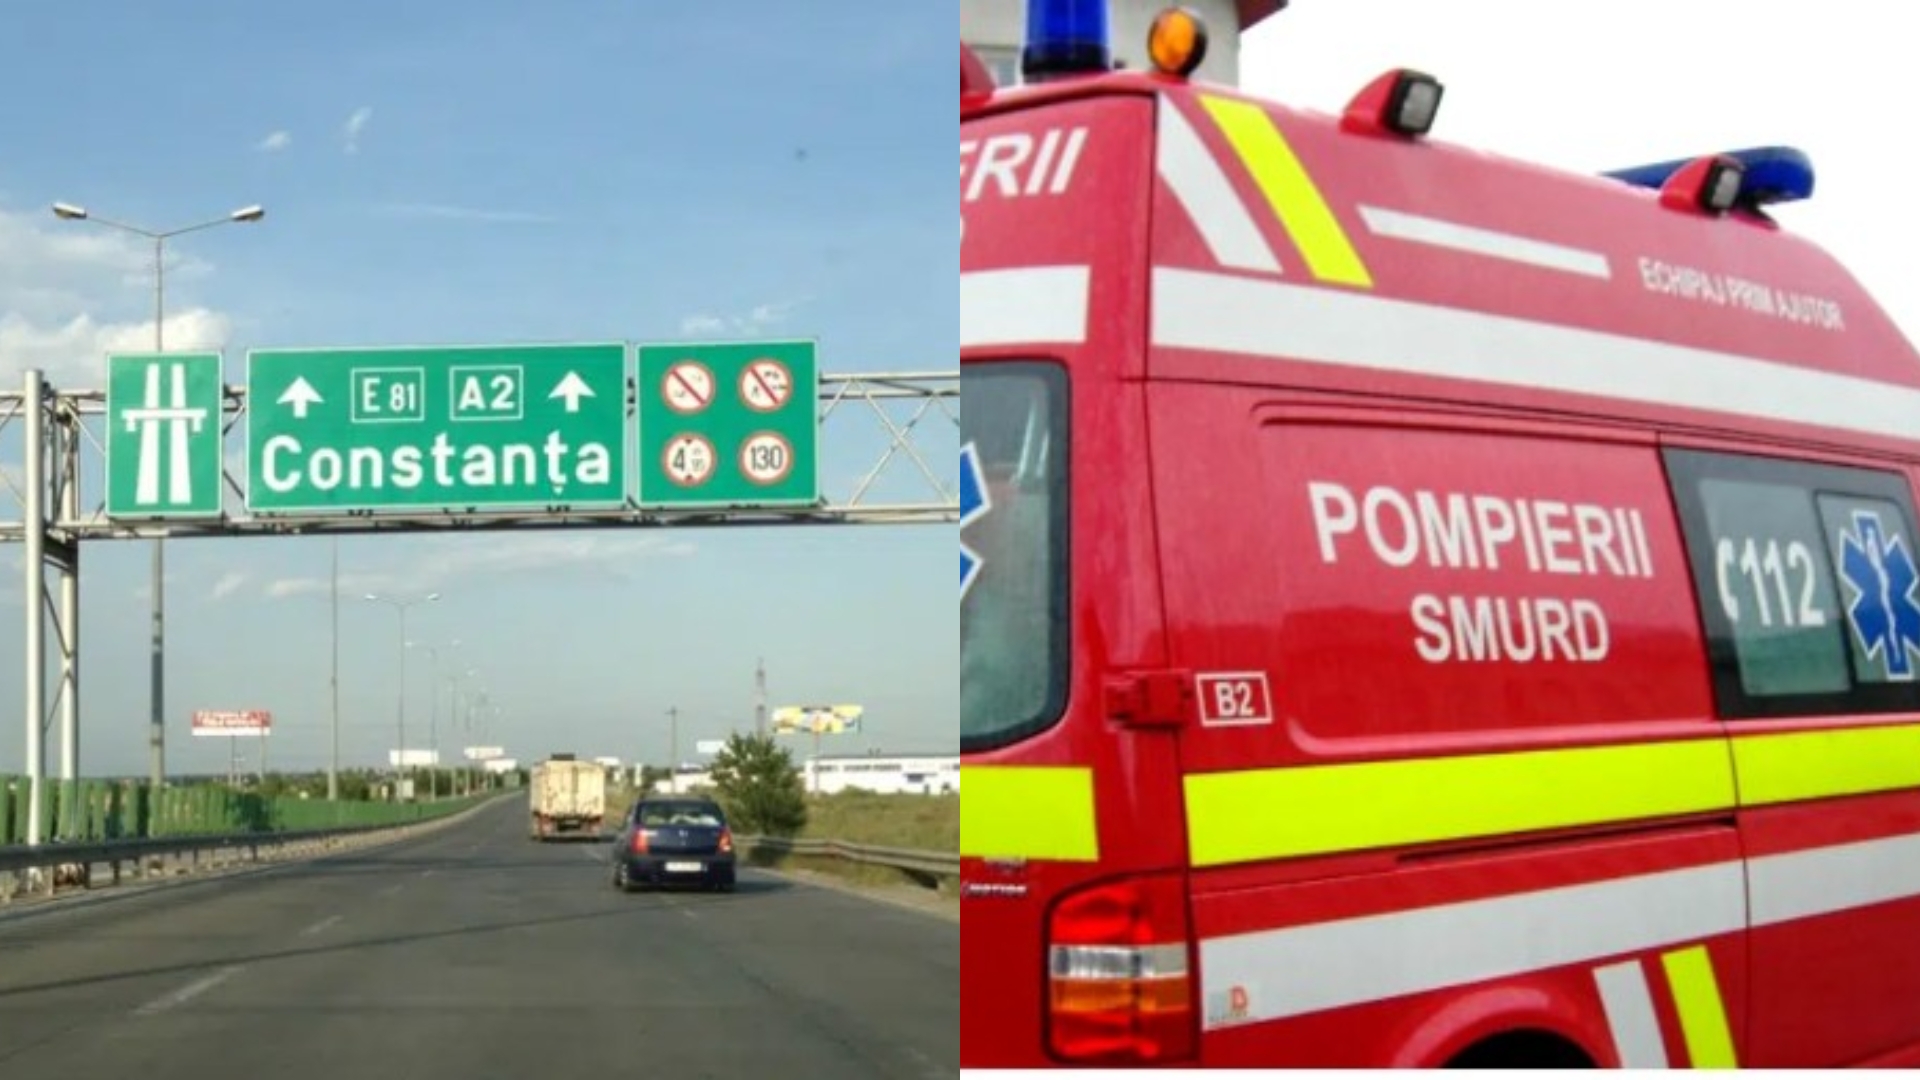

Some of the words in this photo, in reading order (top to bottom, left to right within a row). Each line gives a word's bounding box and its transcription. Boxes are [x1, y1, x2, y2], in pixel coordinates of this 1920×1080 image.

[1638, 255, 1725, 306] ECHIPAJ
[1775, 289, 1846, 332] AJUTOR
[362, 377, 381, 413] E
[389, 382, 416, 413] 81
[458, 374, 515, 411] A2
[262, 431, 611, 495] Constanța
[750, 444, 784, 472] 130
[1307, 480, 1654, 578] POMPIERII
[1410, 594, 1609, 662] SMURD
[1214, 681, 1255, 717] B2
